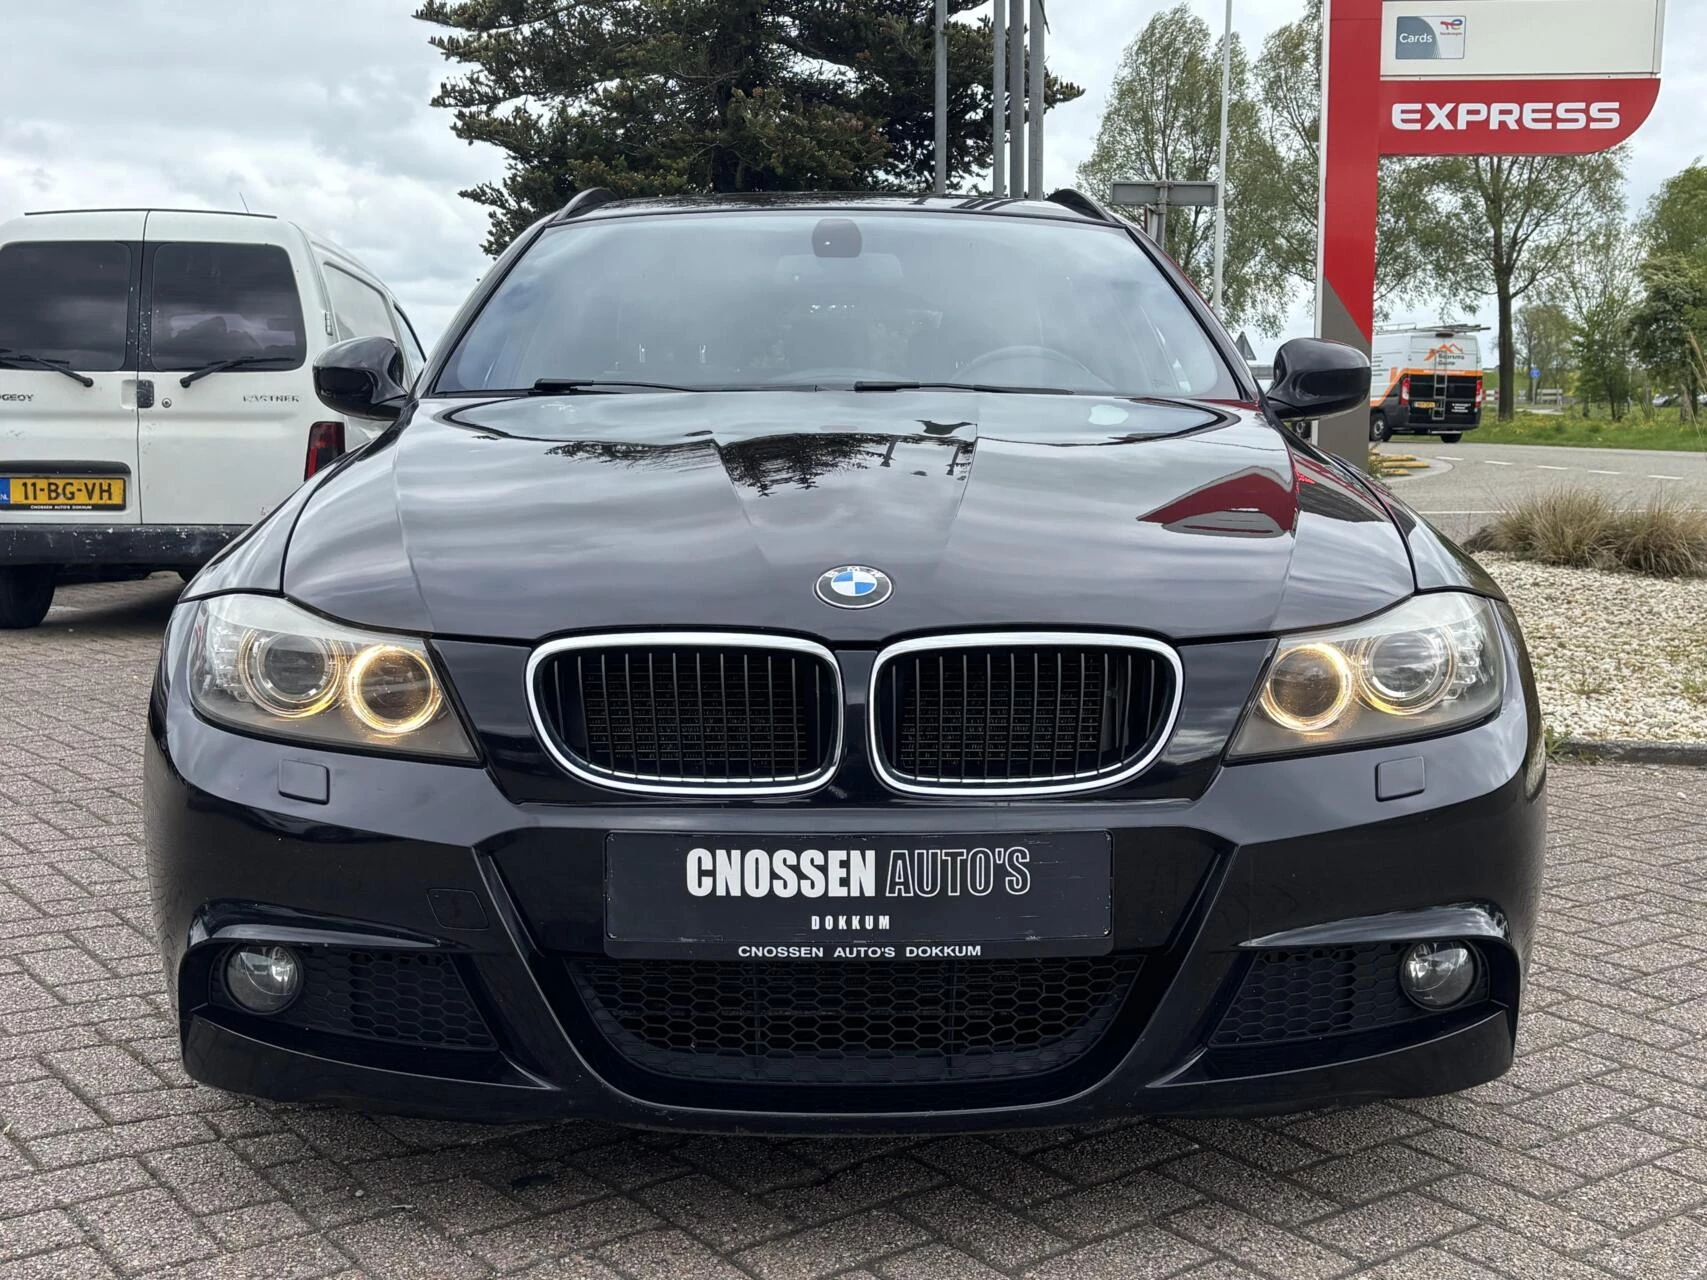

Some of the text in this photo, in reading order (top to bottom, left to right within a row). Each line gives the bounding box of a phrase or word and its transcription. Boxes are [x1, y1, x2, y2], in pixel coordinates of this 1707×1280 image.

[1400, 32, 1433, 43] Cards
[1391, 101, 1620, 131] EXPRESS
[22, 481, 113, 501] 11-BG-VH
[686, 846, 1031, 898] CNOSSEN AUTO'S
[811, 914, 891, 931] DOKKUM
[738, 944, 982, 958] CNOSSEN AUTO'S DOKKUM
